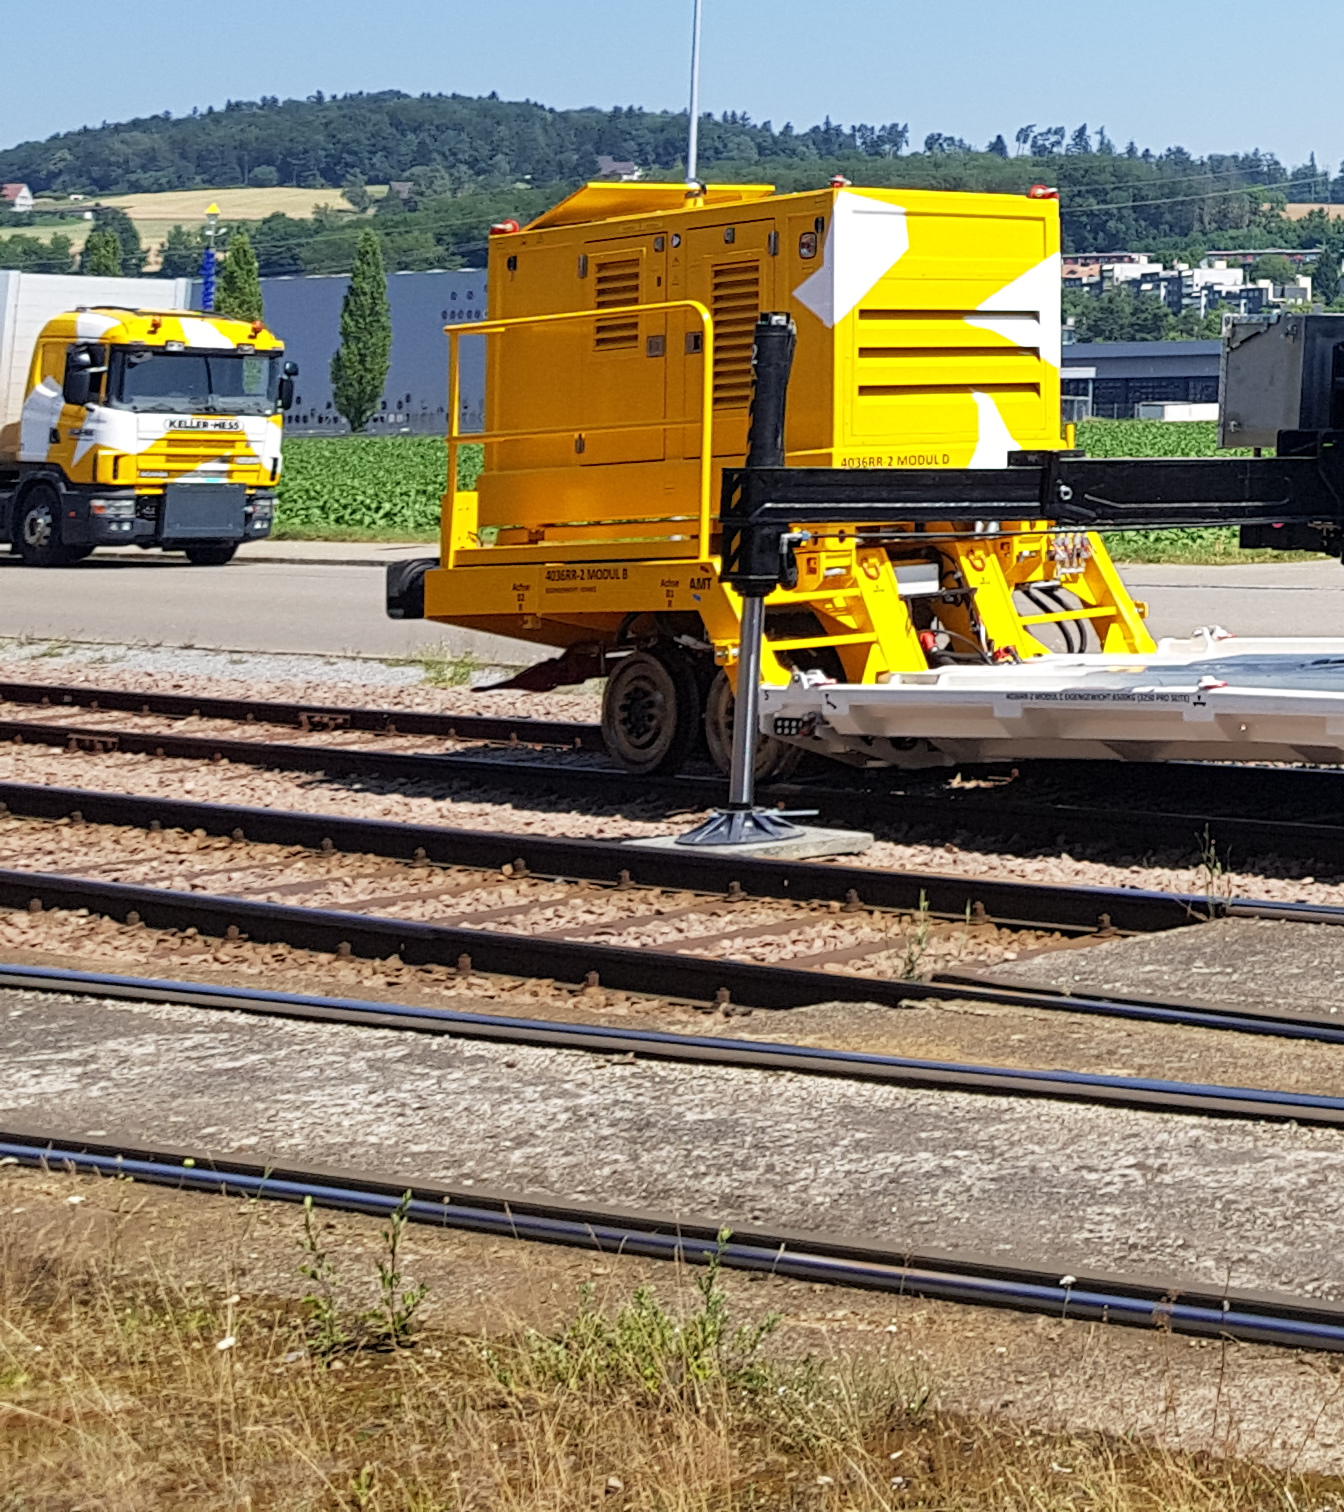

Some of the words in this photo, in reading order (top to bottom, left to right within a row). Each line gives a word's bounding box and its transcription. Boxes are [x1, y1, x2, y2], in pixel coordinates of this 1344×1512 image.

[897, 454, 939, 466] MODUL
[587, 568, 622, 581] MODUL
[689, 577, 712, 590] AMT
